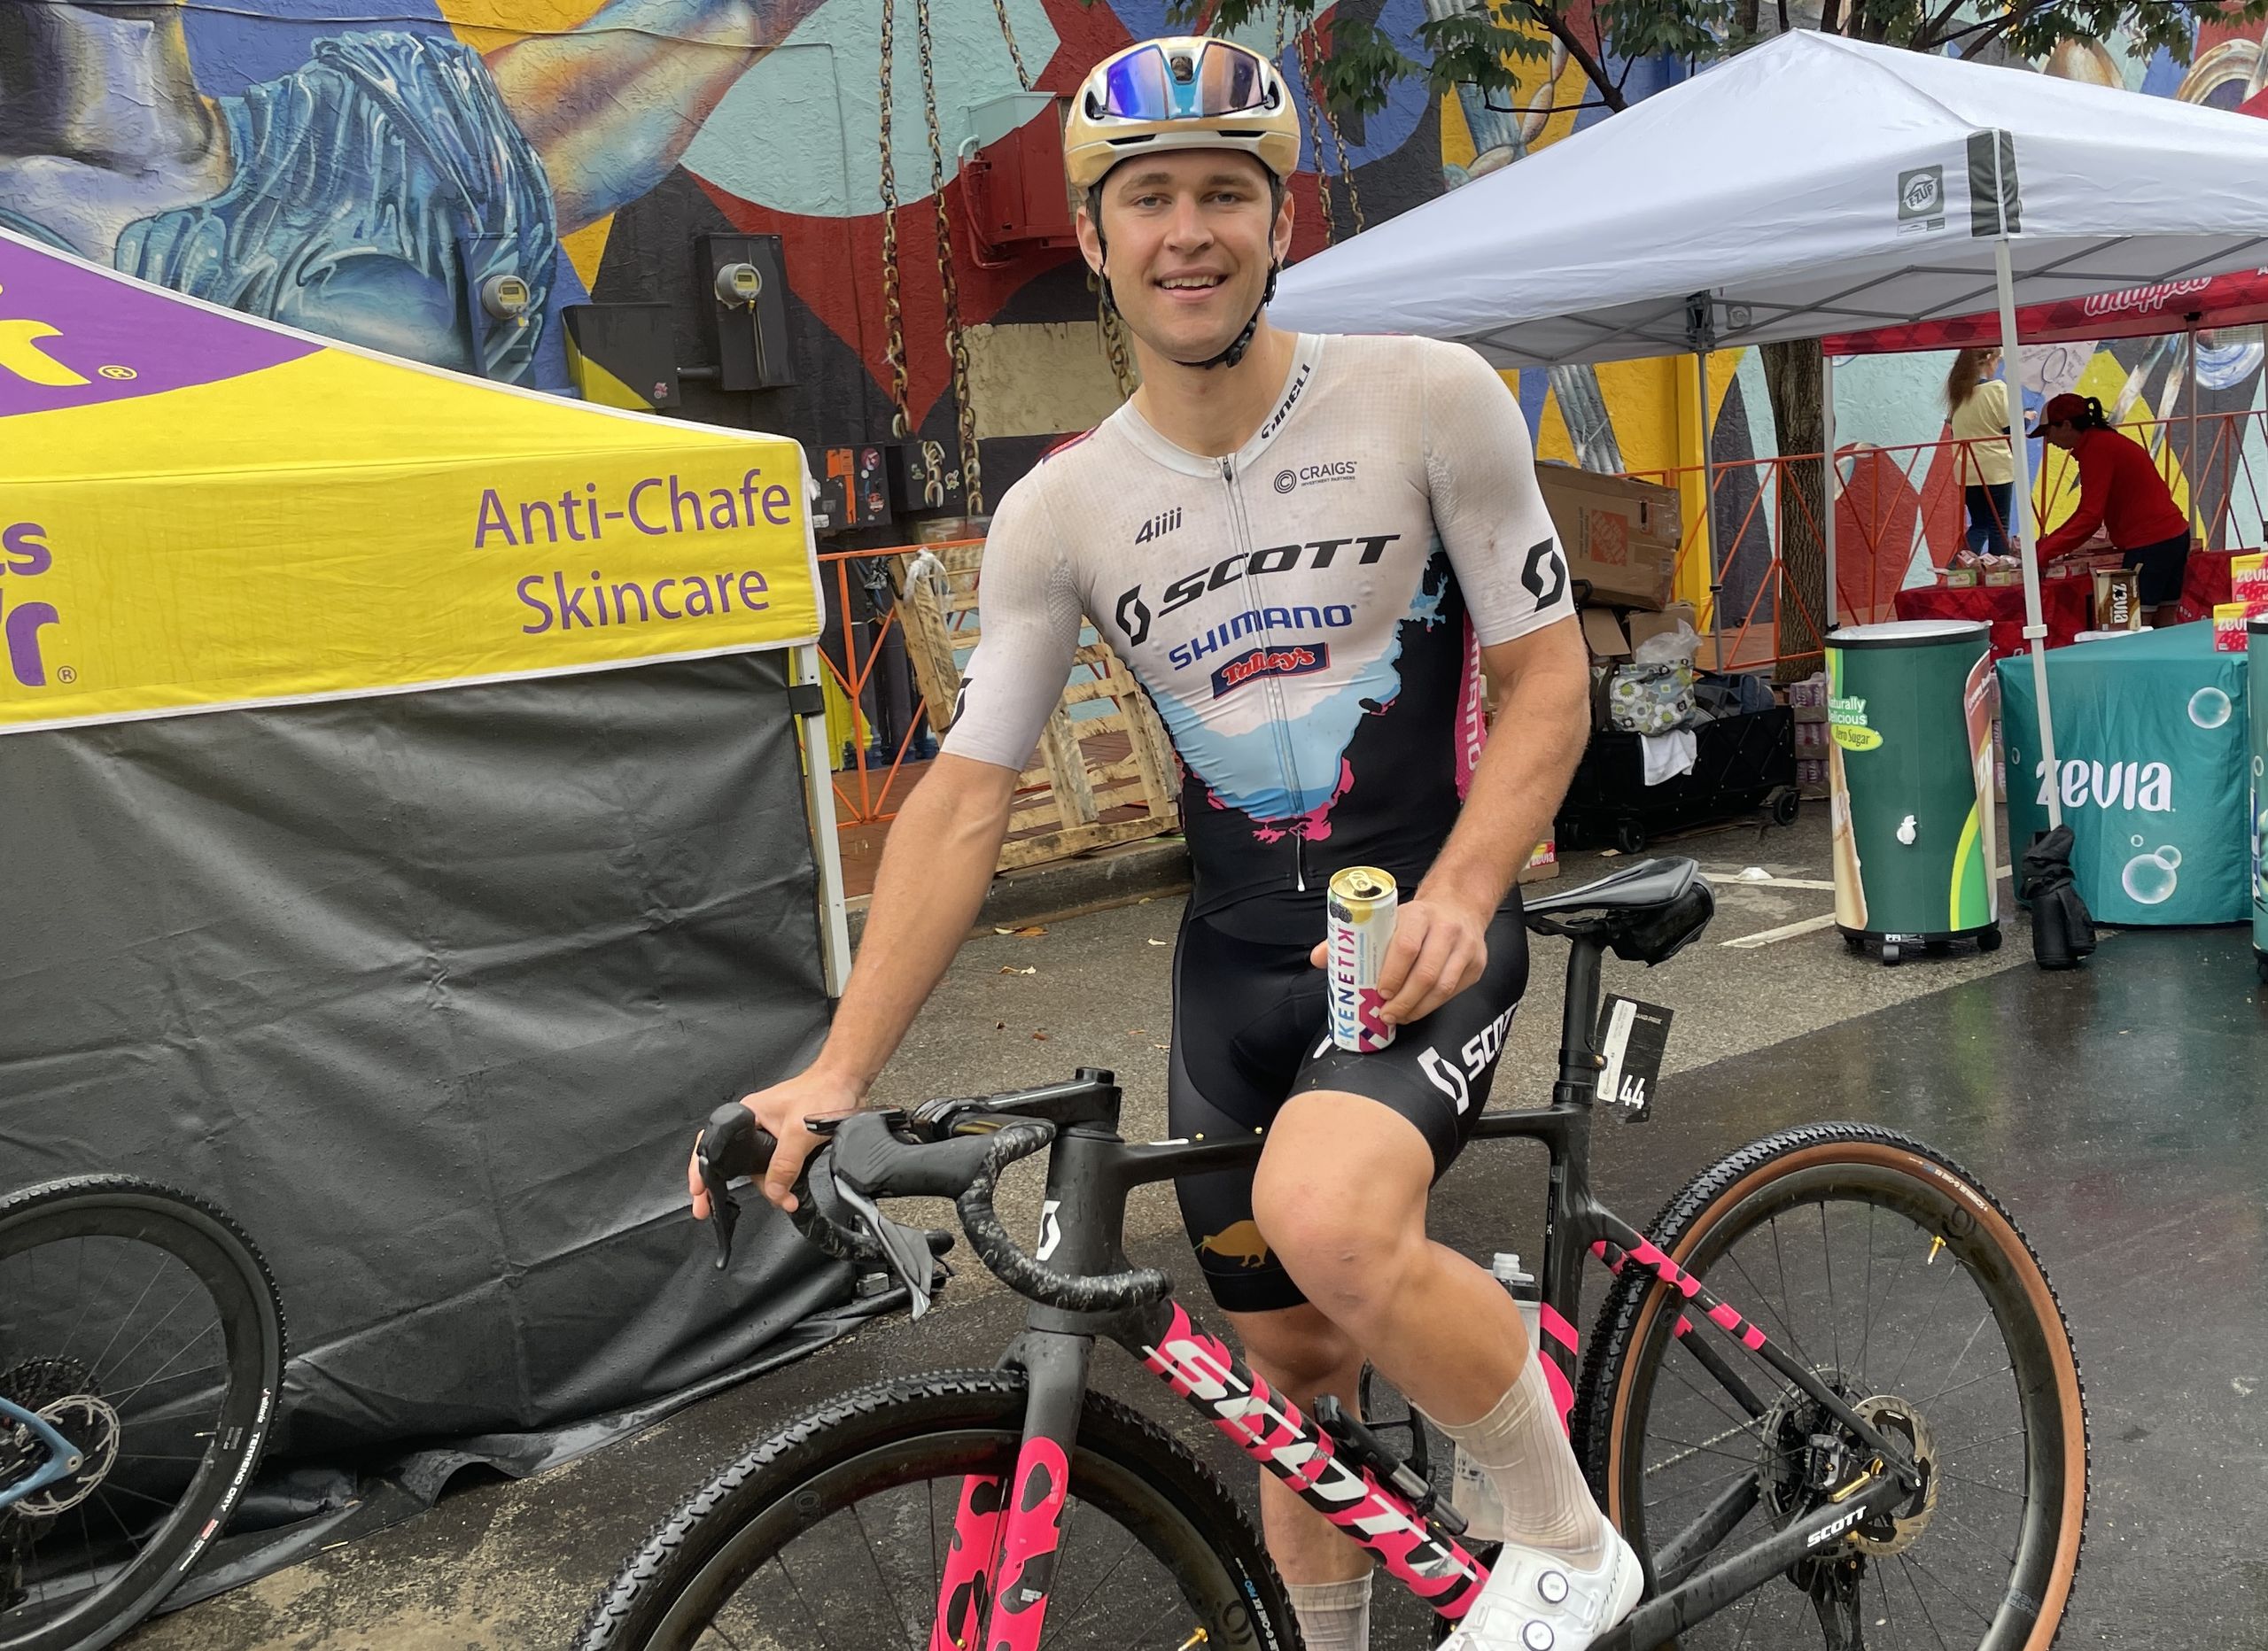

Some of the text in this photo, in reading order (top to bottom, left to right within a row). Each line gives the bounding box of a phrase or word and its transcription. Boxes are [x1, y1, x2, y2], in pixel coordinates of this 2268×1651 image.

[1300, 461, 1356, 480] CRAIGS
[474, 469, 792, 548] Anti-Chafe
[1135, 507, 1182, 545] 4iiii
[1157, 534, 1402, 618] SCOTT
[2236, 567, 2268, 583] zevi
[517, 569, 770, 635] Skincare
[1169, 604, 1353, 671] SHIMANO
[2218, 617, 2248, 632] zevi
[1222, 647, 1316, 686] Talley's
[1848, 729, 1870, 747] Sugar
[1338, 927, 1355, 1040] KENETIK
[1619, 1074, 1646, 1109] 44
[1807, 1506, 1867, 1547] SCOTT
